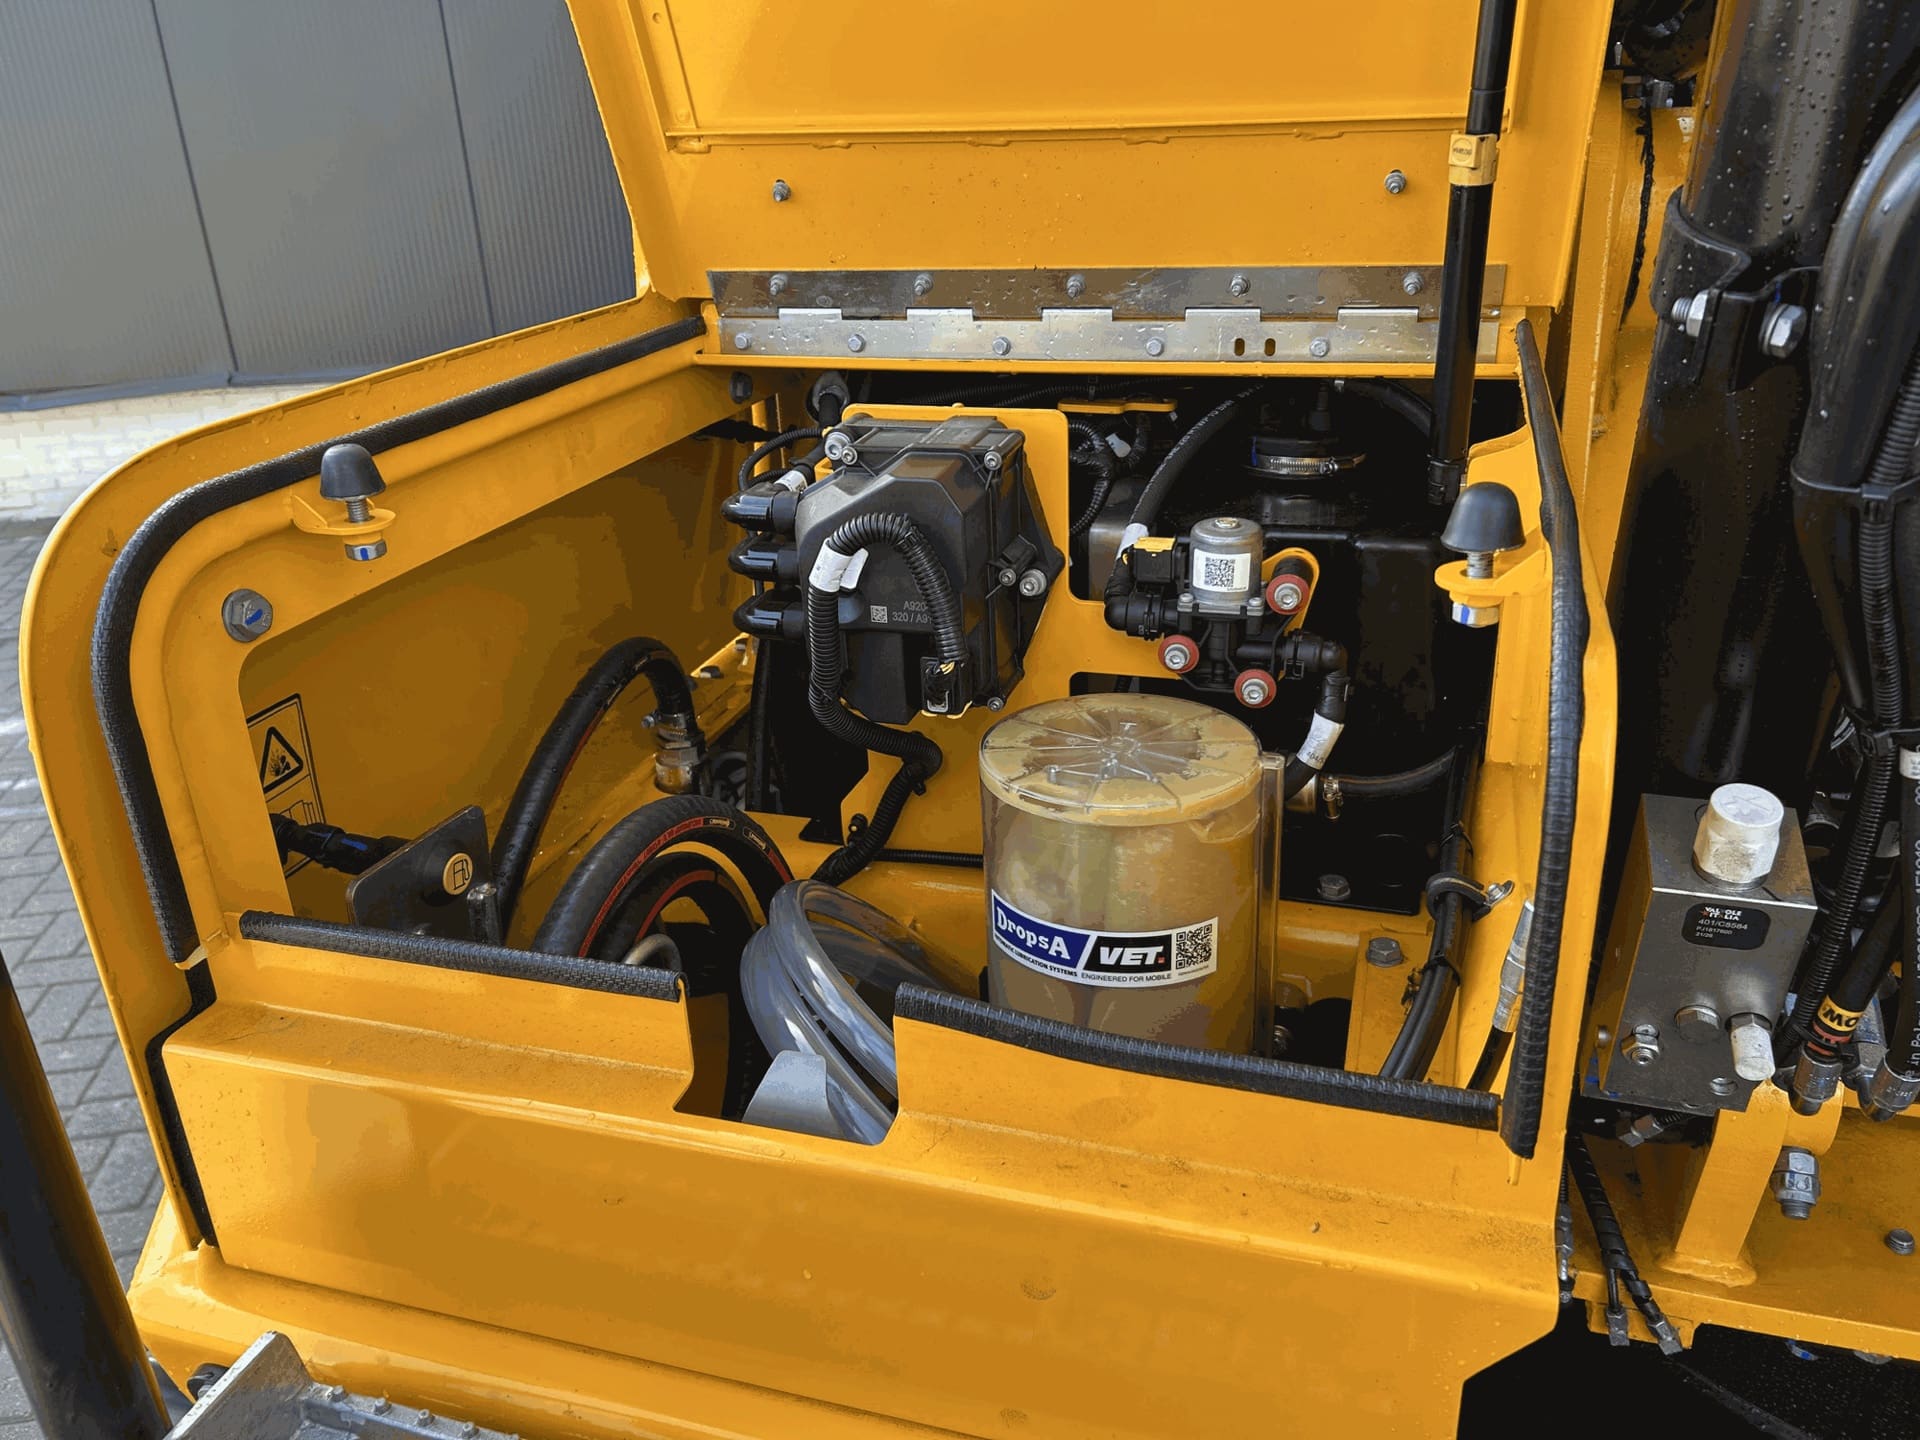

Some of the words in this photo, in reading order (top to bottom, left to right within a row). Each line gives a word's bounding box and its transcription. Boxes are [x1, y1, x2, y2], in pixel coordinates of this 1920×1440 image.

[892, 611, 909, 622] 320
[996, 906, 1071, 960] DropsA
[1049, 964, 1078, 977] SYSTEMS
[1081, 972, 1128, 983] ENGINEERED
[1129, 975, 1145, 983] FOR
[1145, 972, 1172, 982] MOBILE
